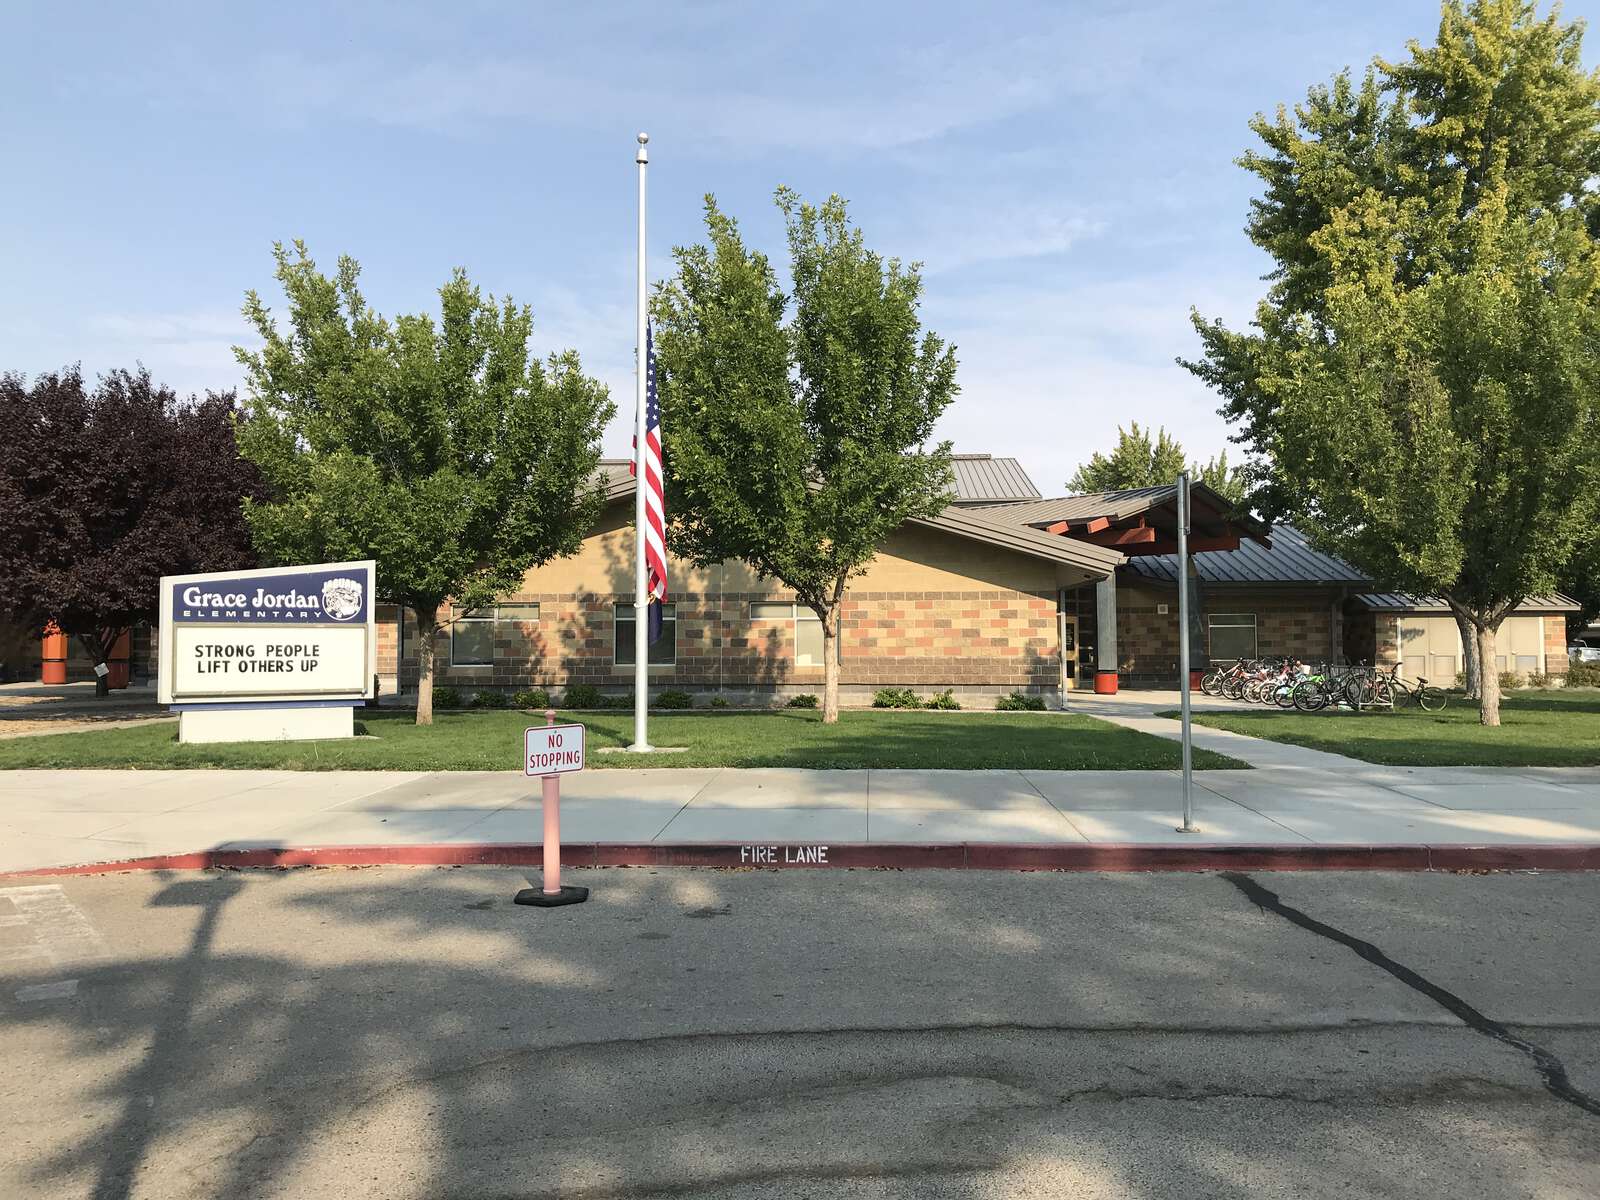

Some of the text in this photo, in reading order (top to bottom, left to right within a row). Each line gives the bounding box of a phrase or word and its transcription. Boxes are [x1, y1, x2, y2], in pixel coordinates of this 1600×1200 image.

[183, 587, 319, 608] Grace Jordan
[183, 610, 322, 618] ELEMENTARY
[195, 644, 320, 658] STRONG PEOPLE
[197, 660, 318, 674] LIFT OTHERS UP
[548, 734, 563, 748] NO
[529, 750, 580, 769] STOPPING
[740, 846, 829, 863] FIRE LANE
